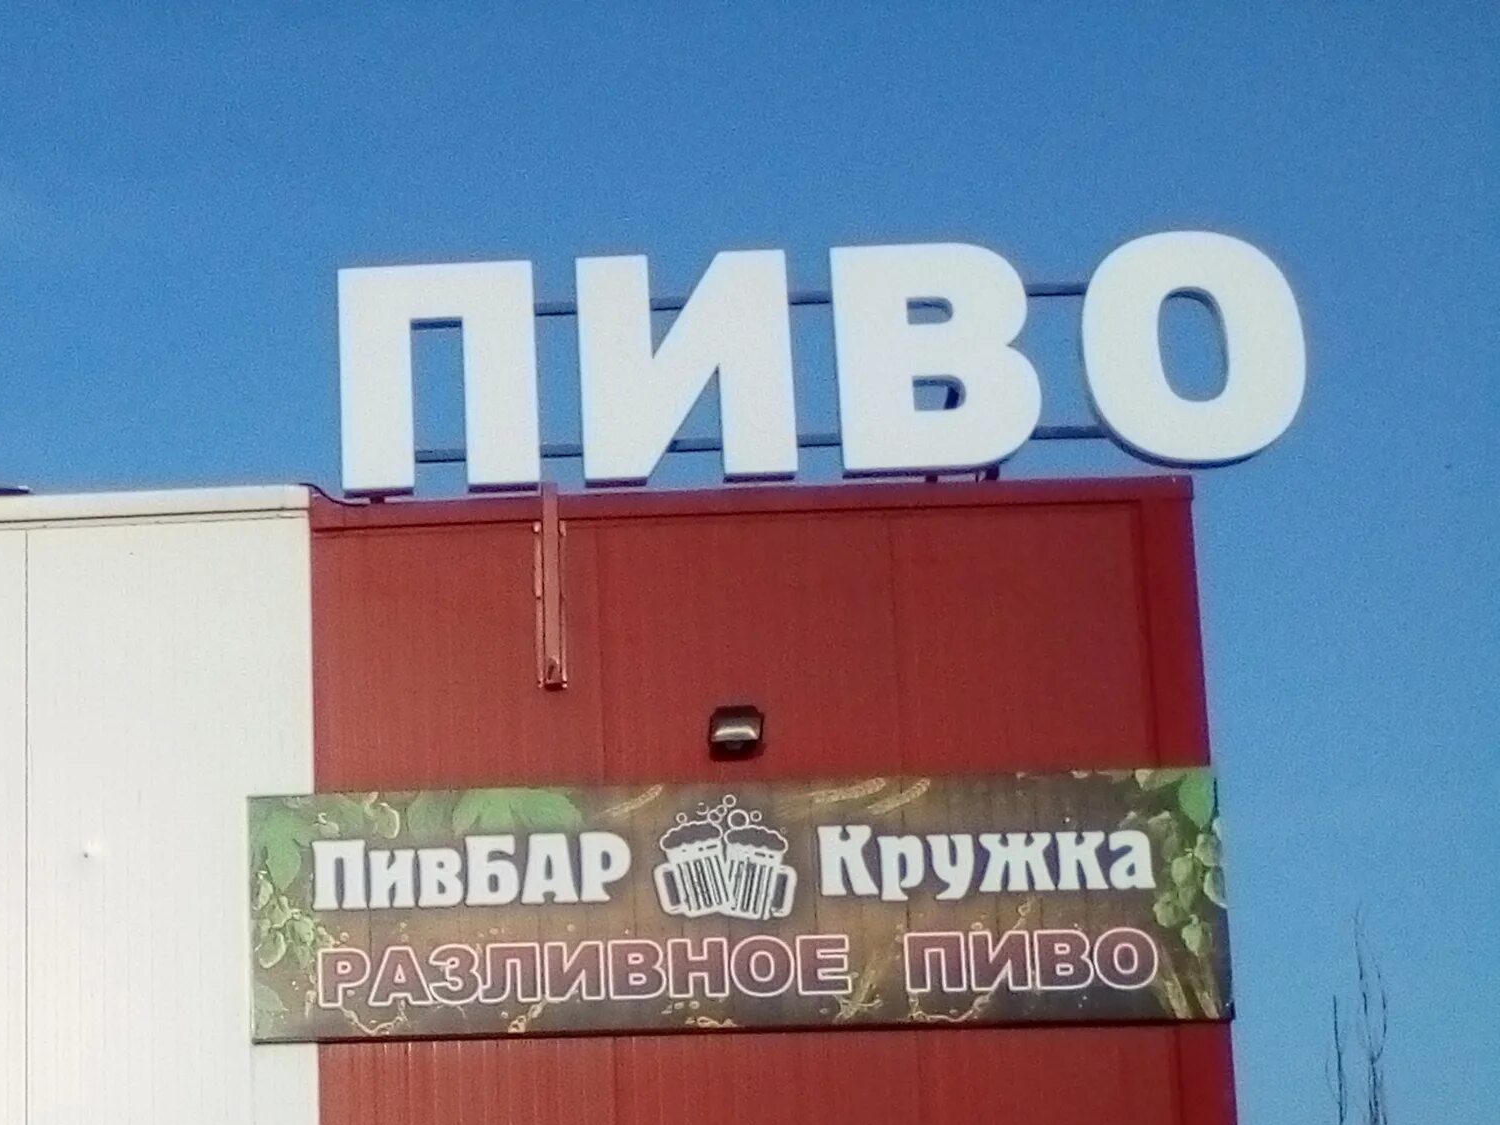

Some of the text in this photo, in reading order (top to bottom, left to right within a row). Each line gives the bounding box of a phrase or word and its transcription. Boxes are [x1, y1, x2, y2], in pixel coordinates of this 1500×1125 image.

[338, 230, 1307, 494] ПИВО
[311, 822, 1156, 912] ПивБАР Кружка
[317, 928, 1160, 1006] РАЗЛИВНОЕ ПИВО
